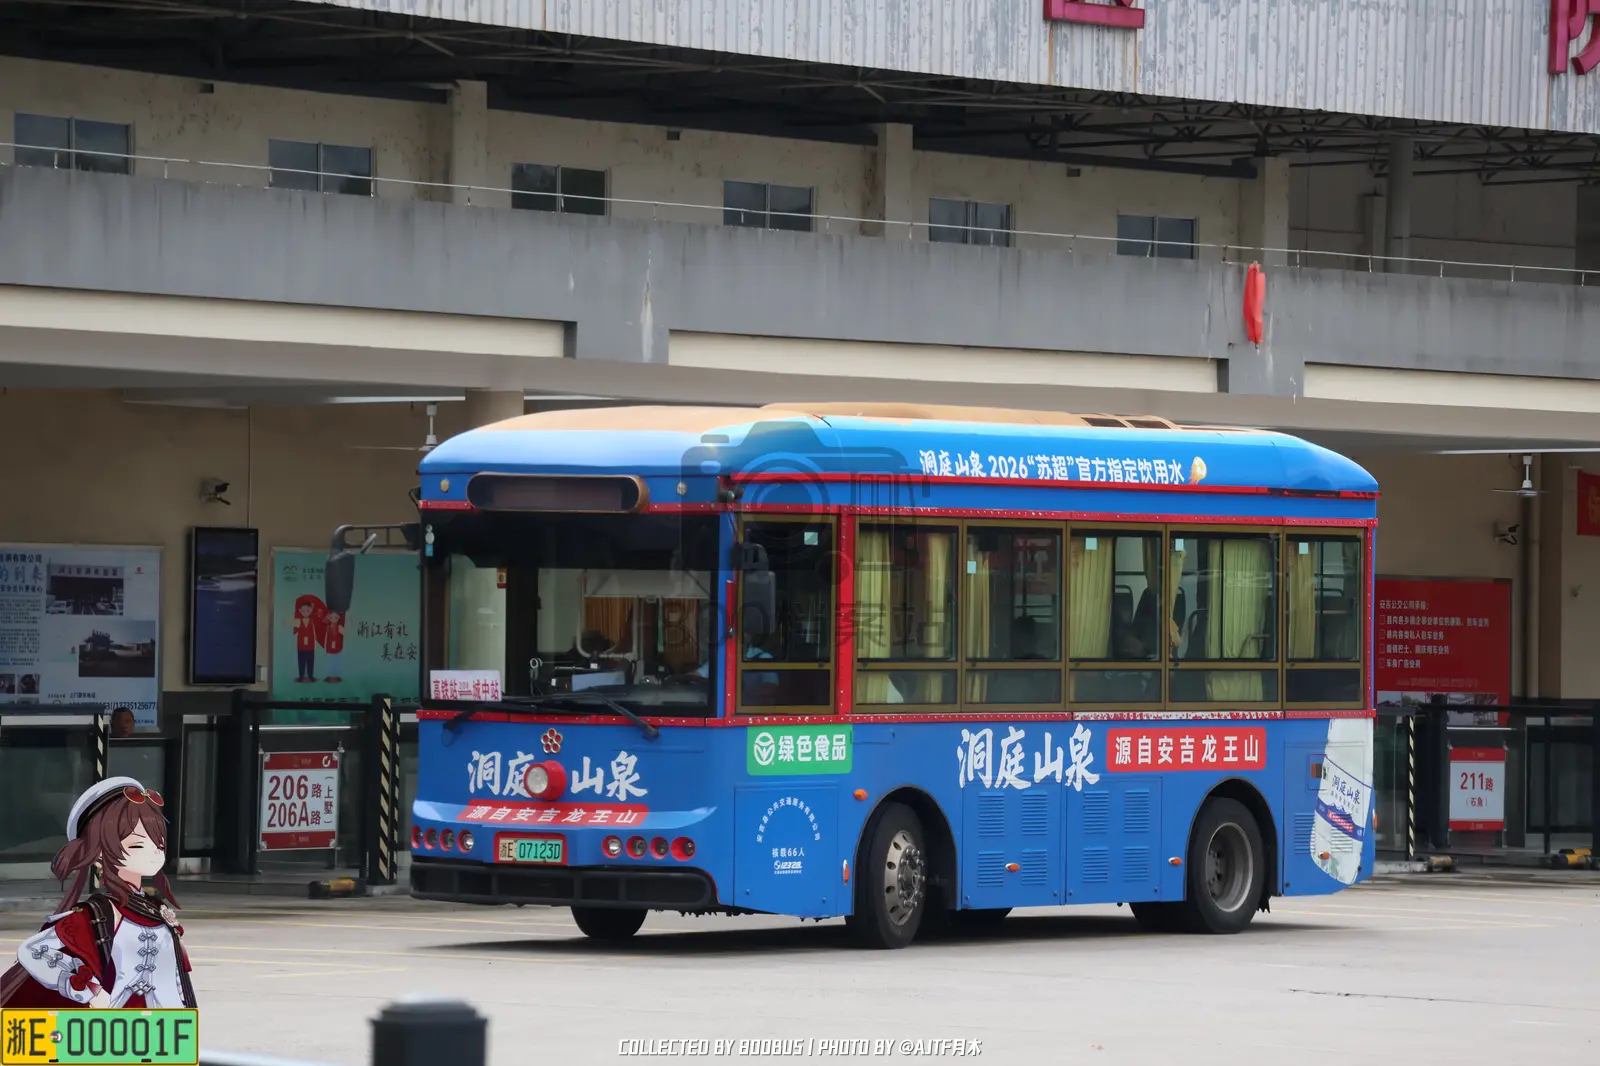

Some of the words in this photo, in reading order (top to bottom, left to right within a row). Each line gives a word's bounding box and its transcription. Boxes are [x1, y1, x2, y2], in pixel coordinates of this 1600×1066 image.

[919, 450, 986, 478] 洞庭山泉
[778, 734, 847, 762] 绿色食品
[957, 723, 1100, 792] 洞庭山泉
[1115, 735, 1259, 766] 源自安吉龙王山
[268, 775, 322, 800] 206路
[1460, 772, 1494, 792] 211路
[267, 801, 321, 828] 206A路
[466, 805, 638, 824] 源自安吉龙王山
[518, 842, 561, 860] 07123D
